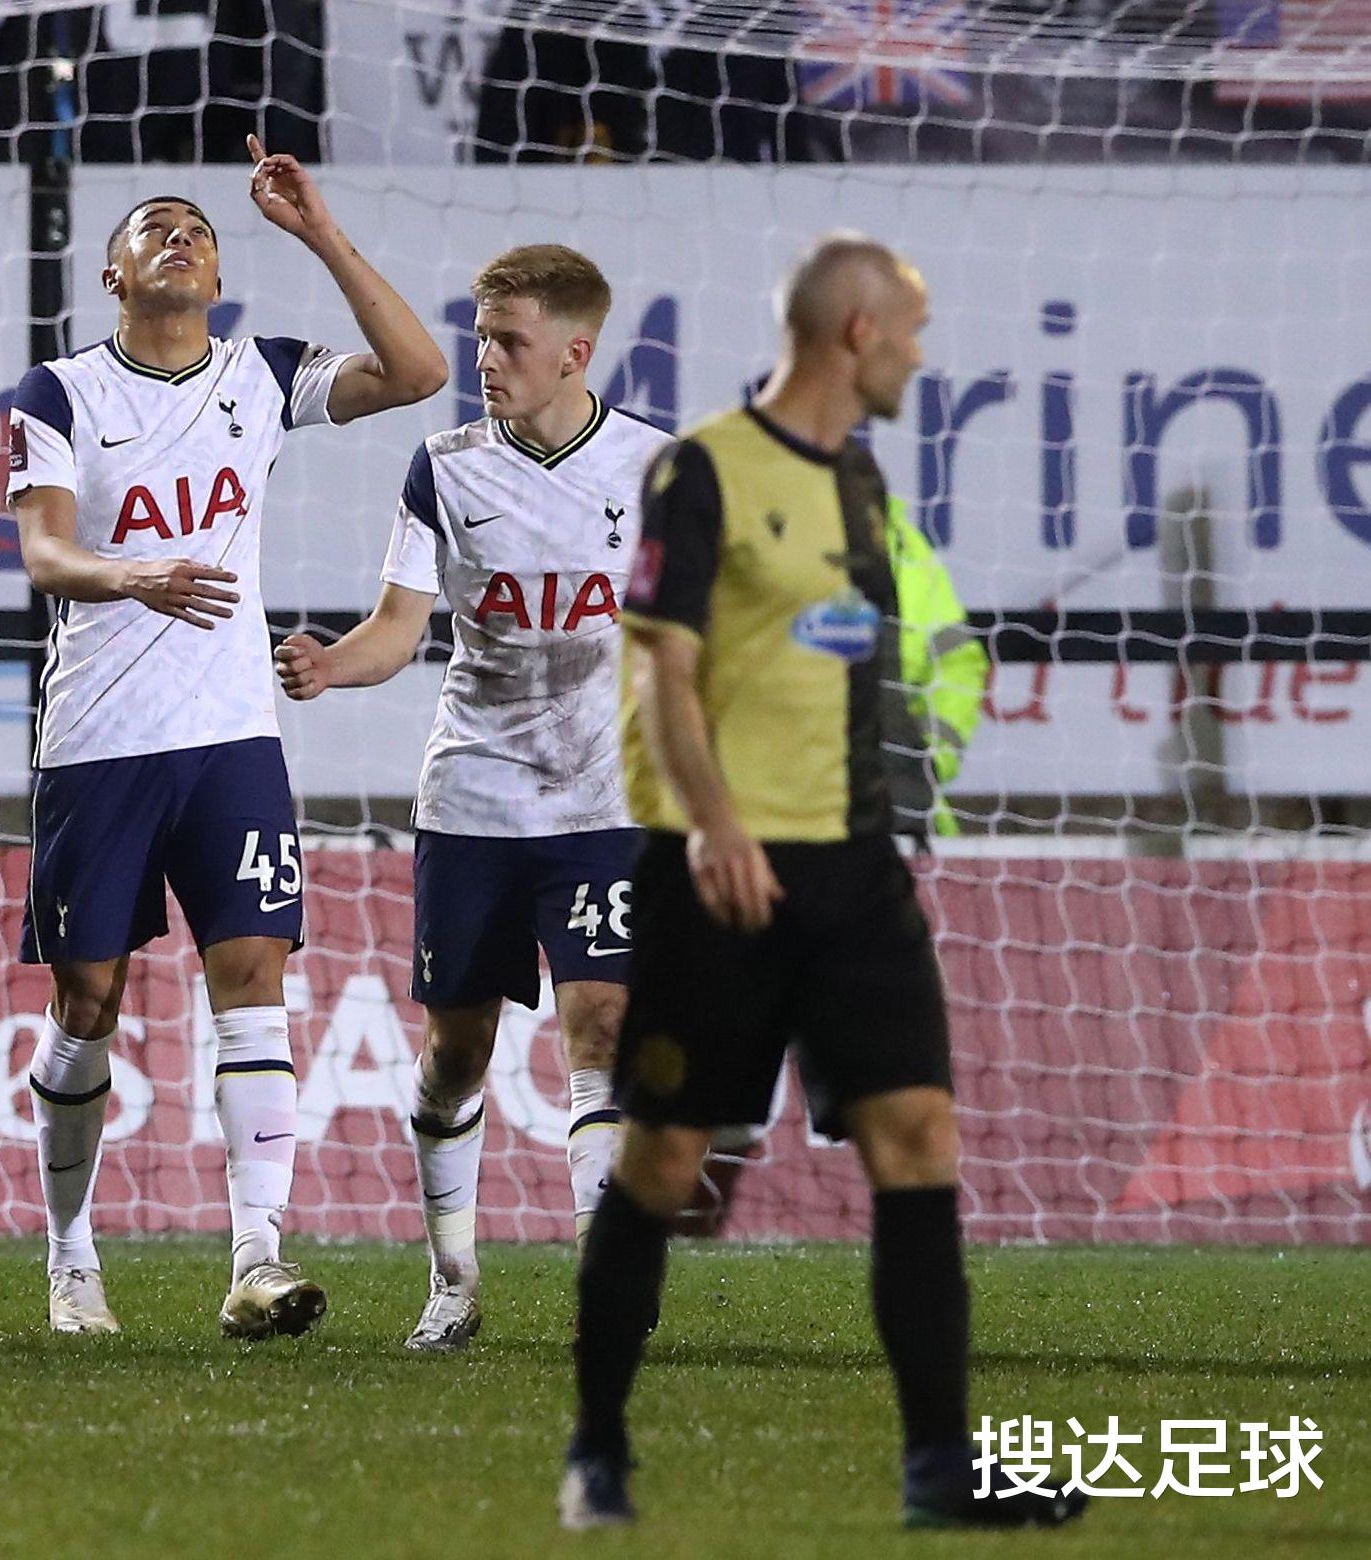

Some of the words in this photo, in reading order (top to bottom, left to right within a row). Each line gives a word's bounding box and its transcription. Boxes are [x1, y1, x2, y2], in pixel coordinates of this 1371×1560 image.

[111, 467, 247, 544] AIA
[476, 572, 618, 631] AIA
[236, 830, 301, 895] 45
[567, 879, 633, 939] 48
